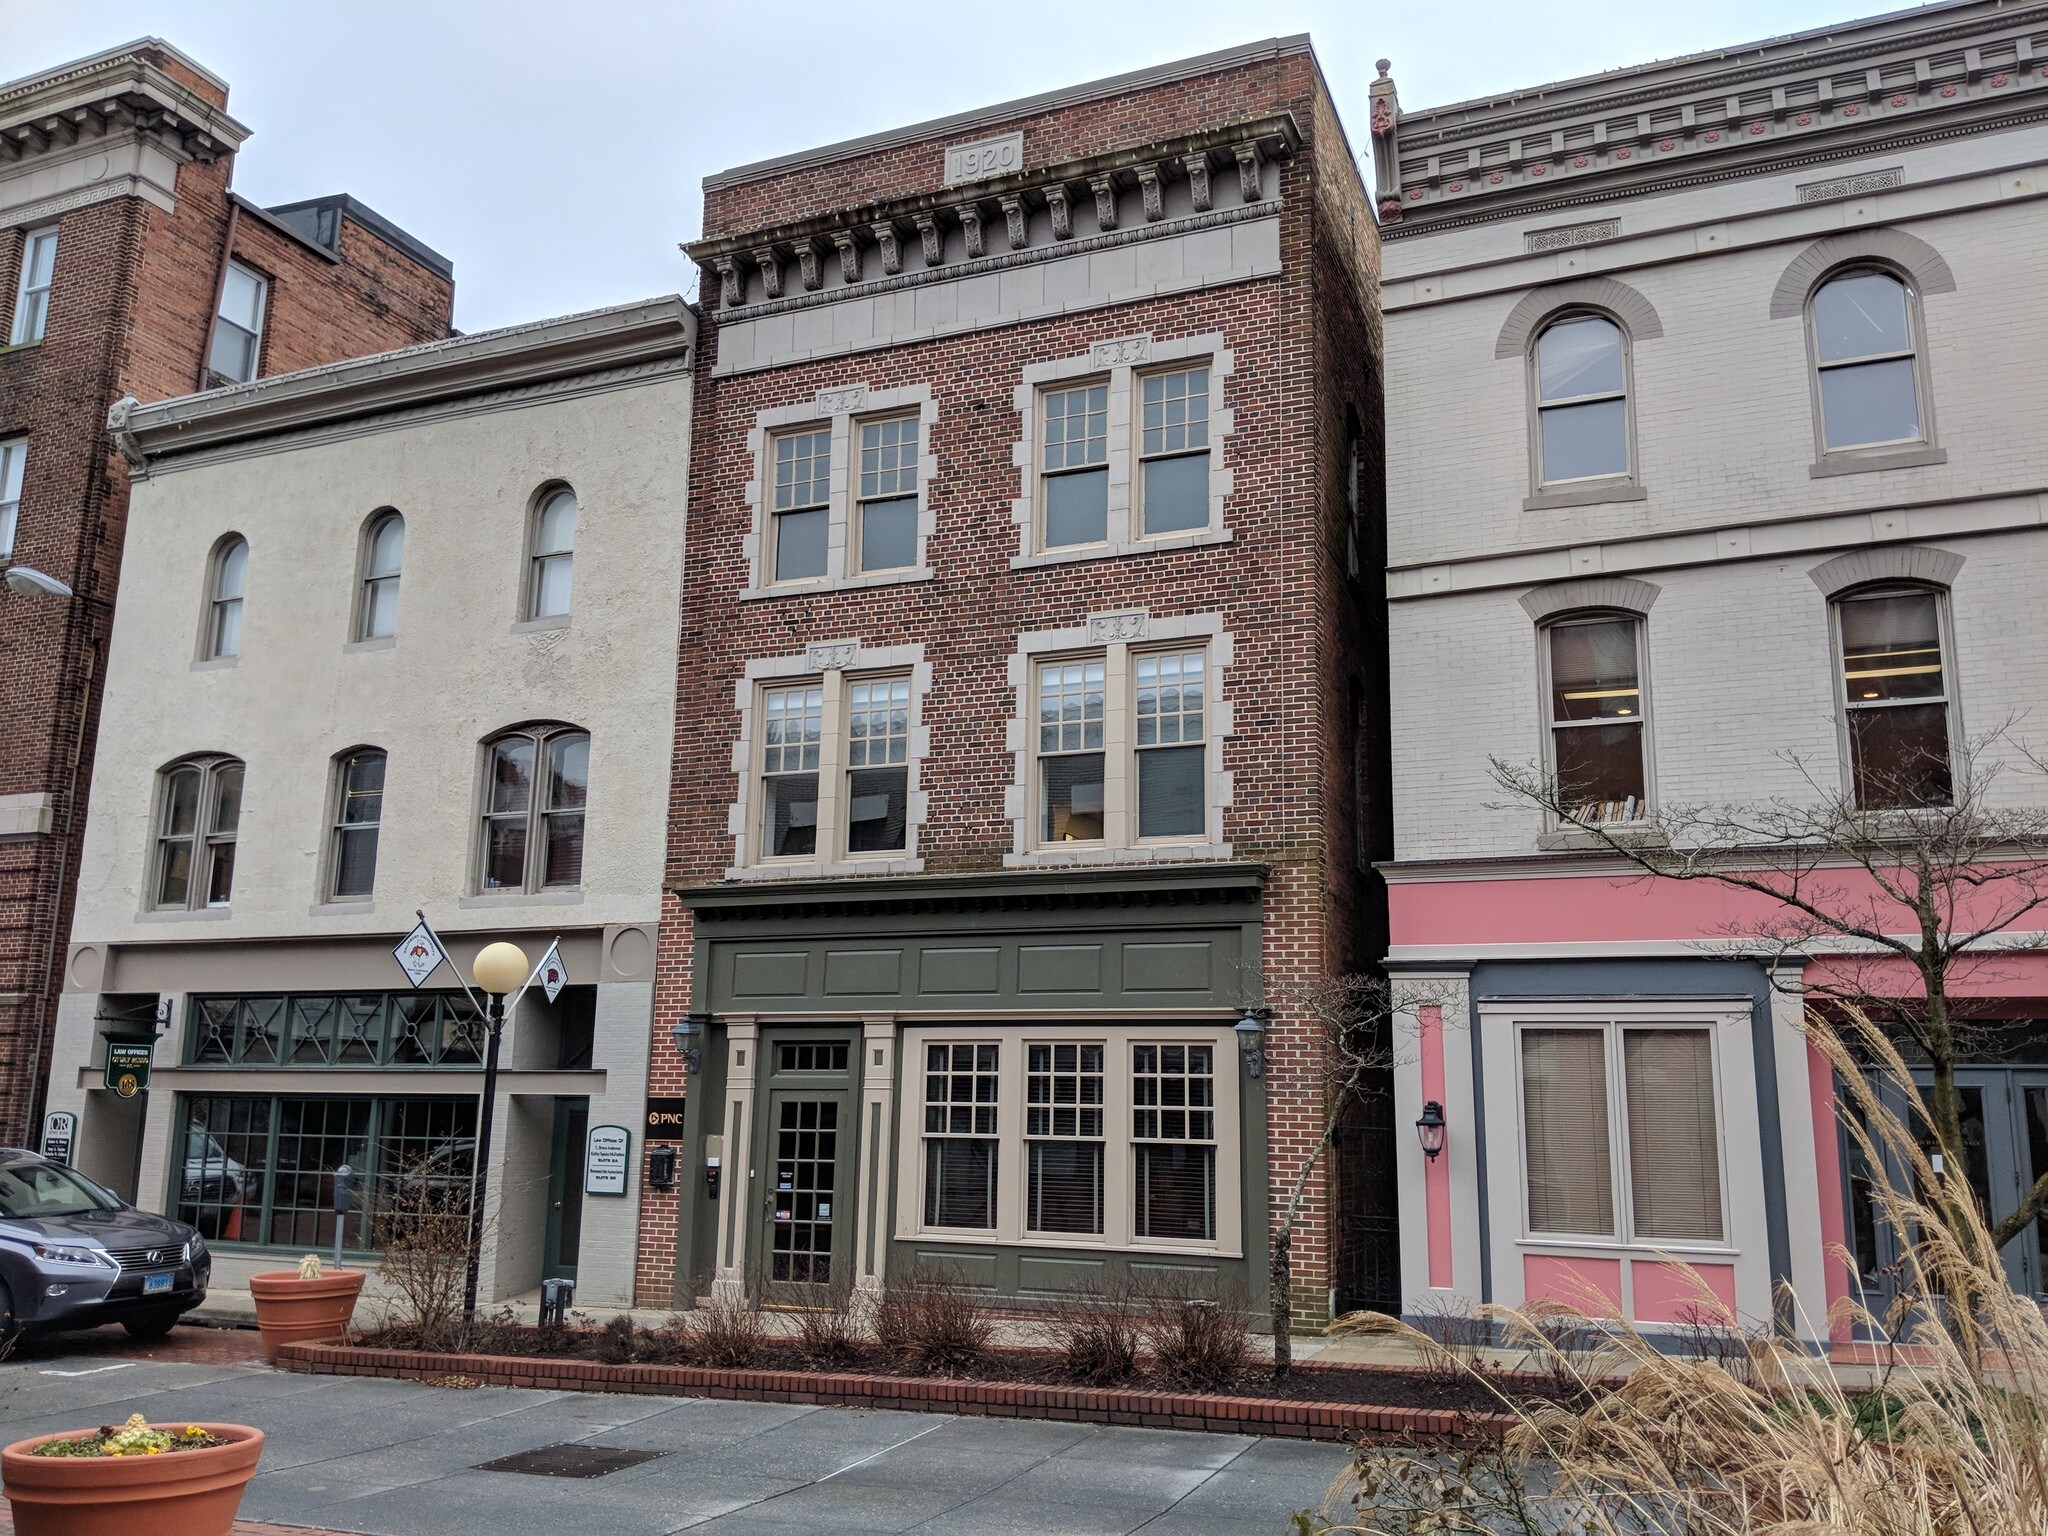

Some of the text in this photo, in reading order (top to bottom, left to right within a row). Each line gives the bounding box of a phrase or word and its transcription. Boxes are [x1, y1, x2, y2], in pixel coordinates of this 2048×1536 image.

[954, 145, 1014, 177] 1920
[403, 934, 435, 956] SALISBURY UNIVERSITY
[660, 1113, 683, 1124] PNC
